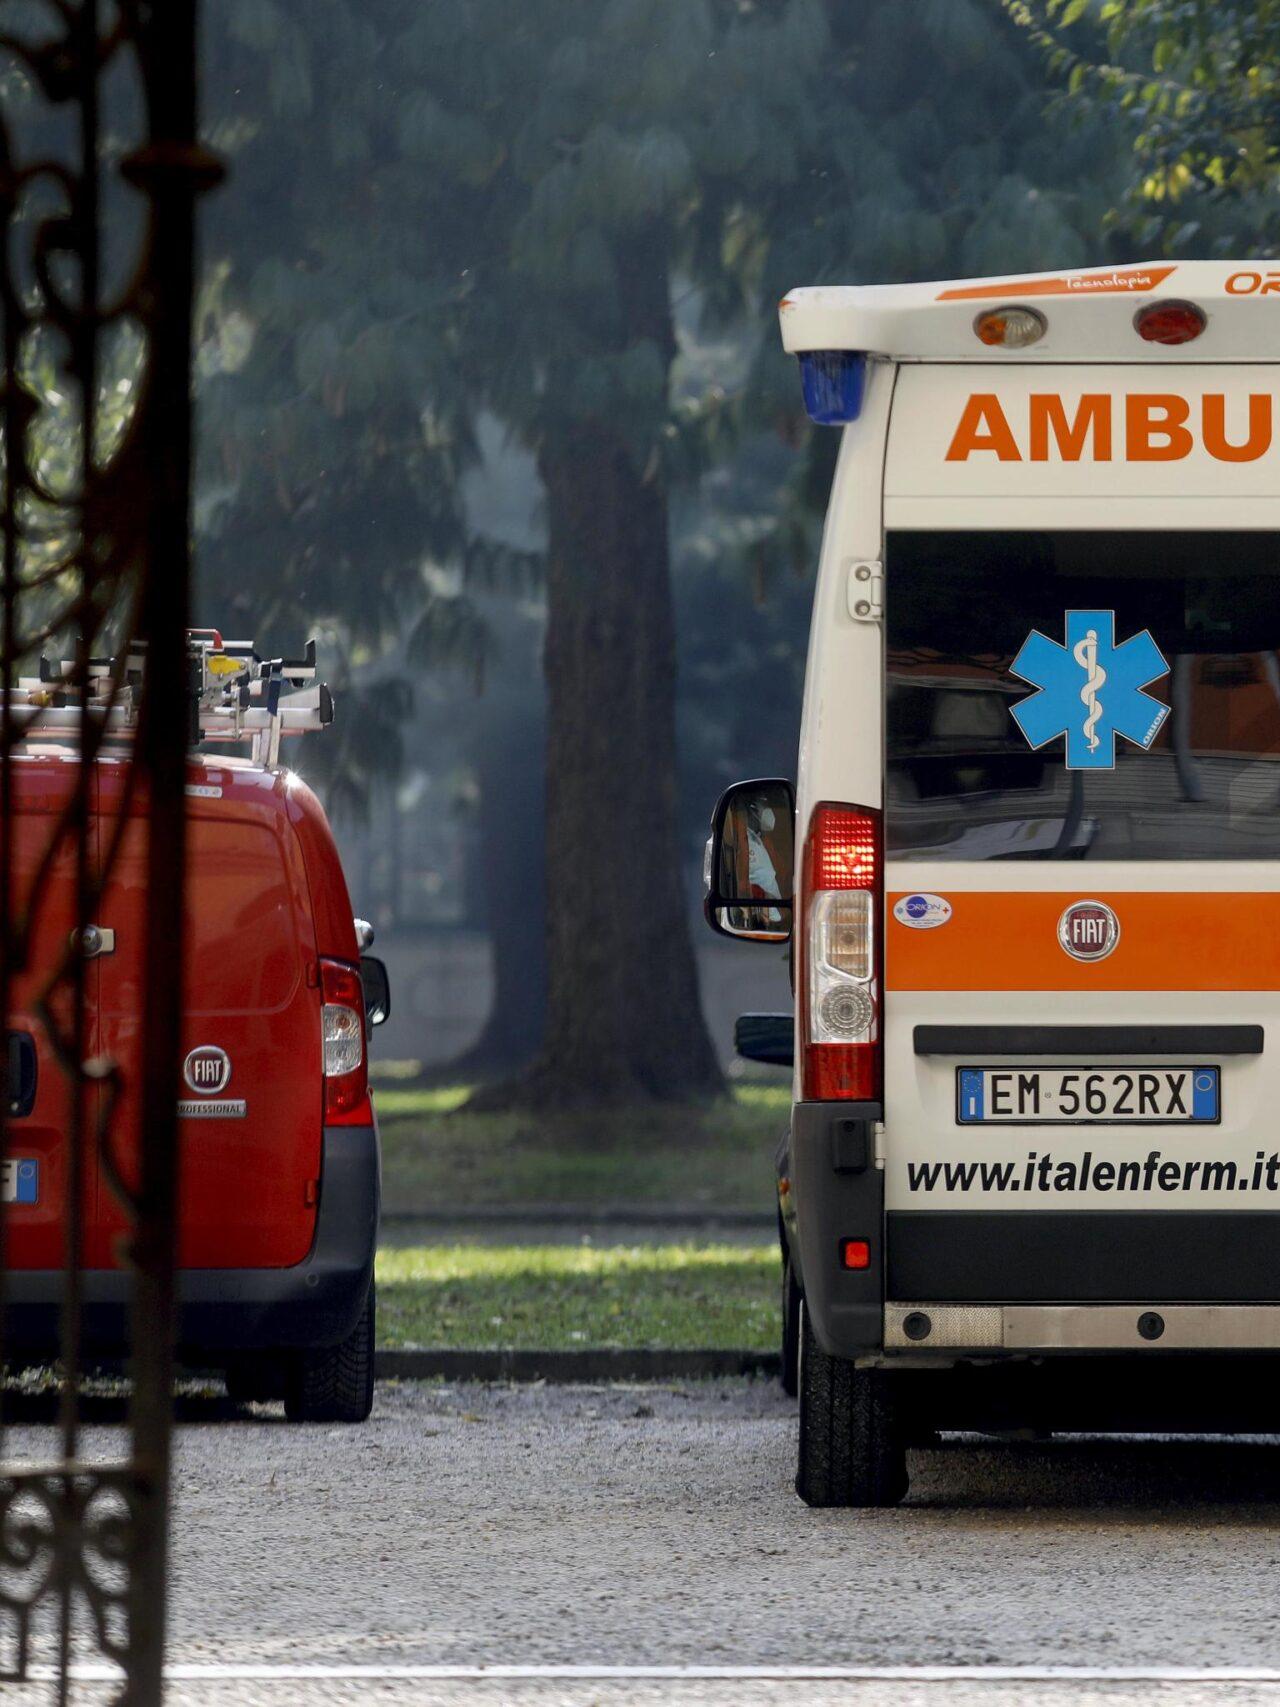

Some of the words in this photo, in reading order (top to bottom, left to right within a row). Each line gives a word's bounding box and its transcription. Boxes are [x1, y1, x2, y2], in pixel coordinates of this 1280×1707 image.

[1143, 708, 1167, 746] ORION
[1073, 918, 1106, 944] FIAT
[194, 1060, 222, 1083] FIAT
[991, 1074, 1041, 1115] EM
[1058, 1074, 1187, 1116] 562RX
[907, 1151, 1280, 1192] www.italenferm.it
